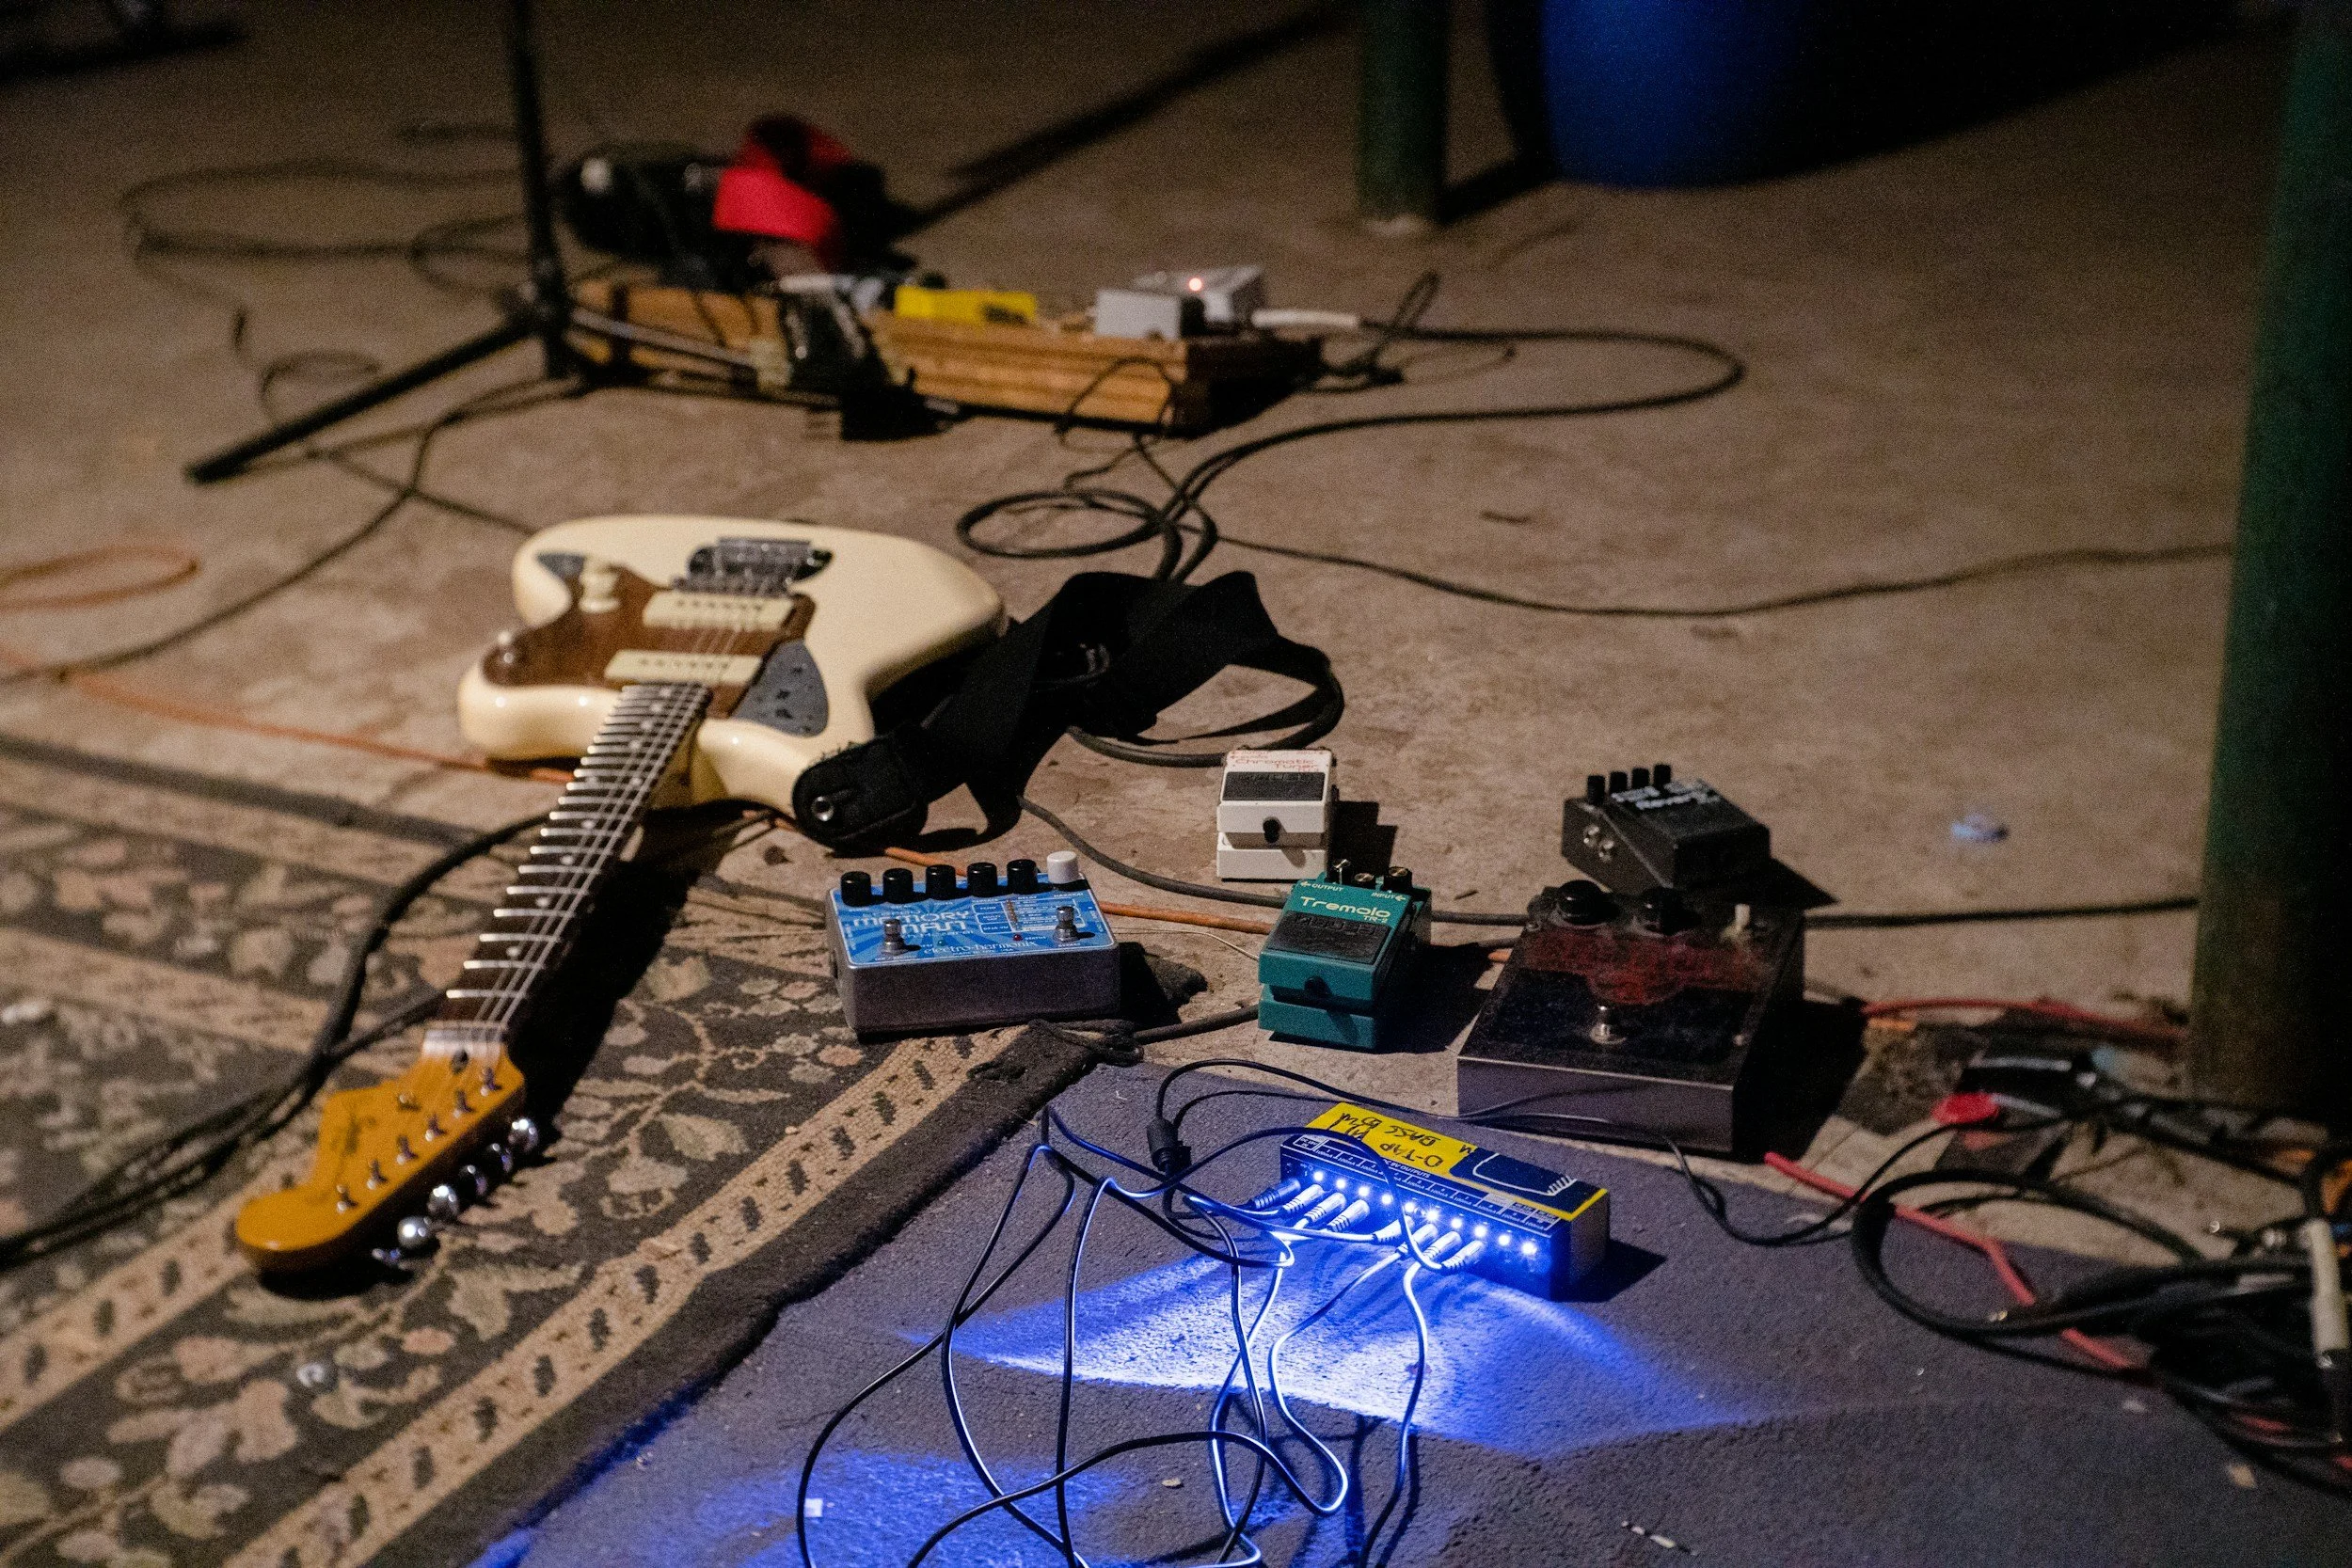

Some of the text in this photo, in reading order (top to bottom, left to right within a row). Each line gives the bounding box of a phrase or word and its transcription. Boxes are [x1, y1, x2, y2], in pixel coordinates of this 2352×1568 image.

[1311, 883, 1343, 892] OUTPUT
[1300, 895, 1391, 918] Tremolo
[1363, 915, 1389, 924] TR-2
[1400, 1164, 1431, 1178] OUTPUTS
